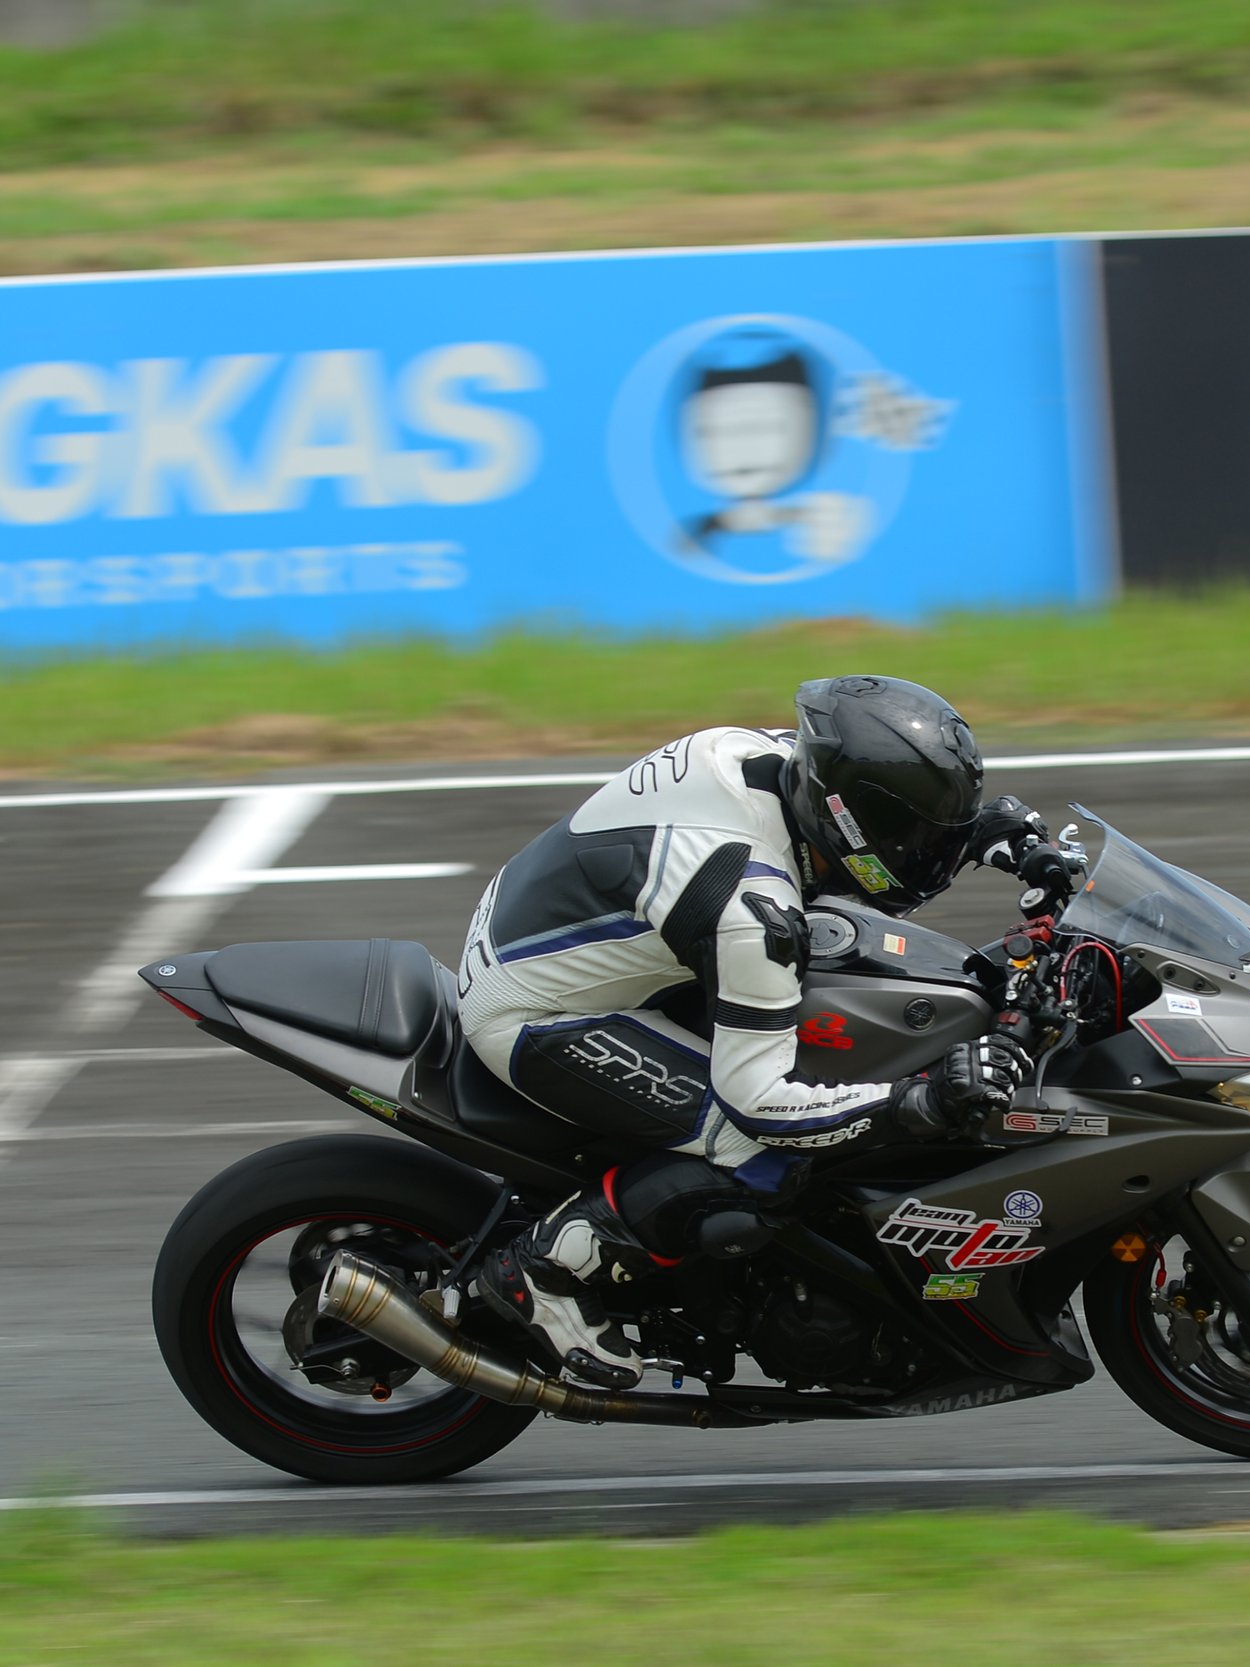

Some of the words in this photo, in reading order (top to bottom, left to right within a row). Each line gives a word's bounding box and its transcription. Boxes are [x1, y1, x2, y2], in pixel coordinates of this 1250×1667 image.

[569, 1030, 706, 1104] SPRS
[756, 1105, 789, 1113] SPEED
[924, 1274, 985, 1299] 55
[891, 1384, 1017, 1416] YAMAHA
